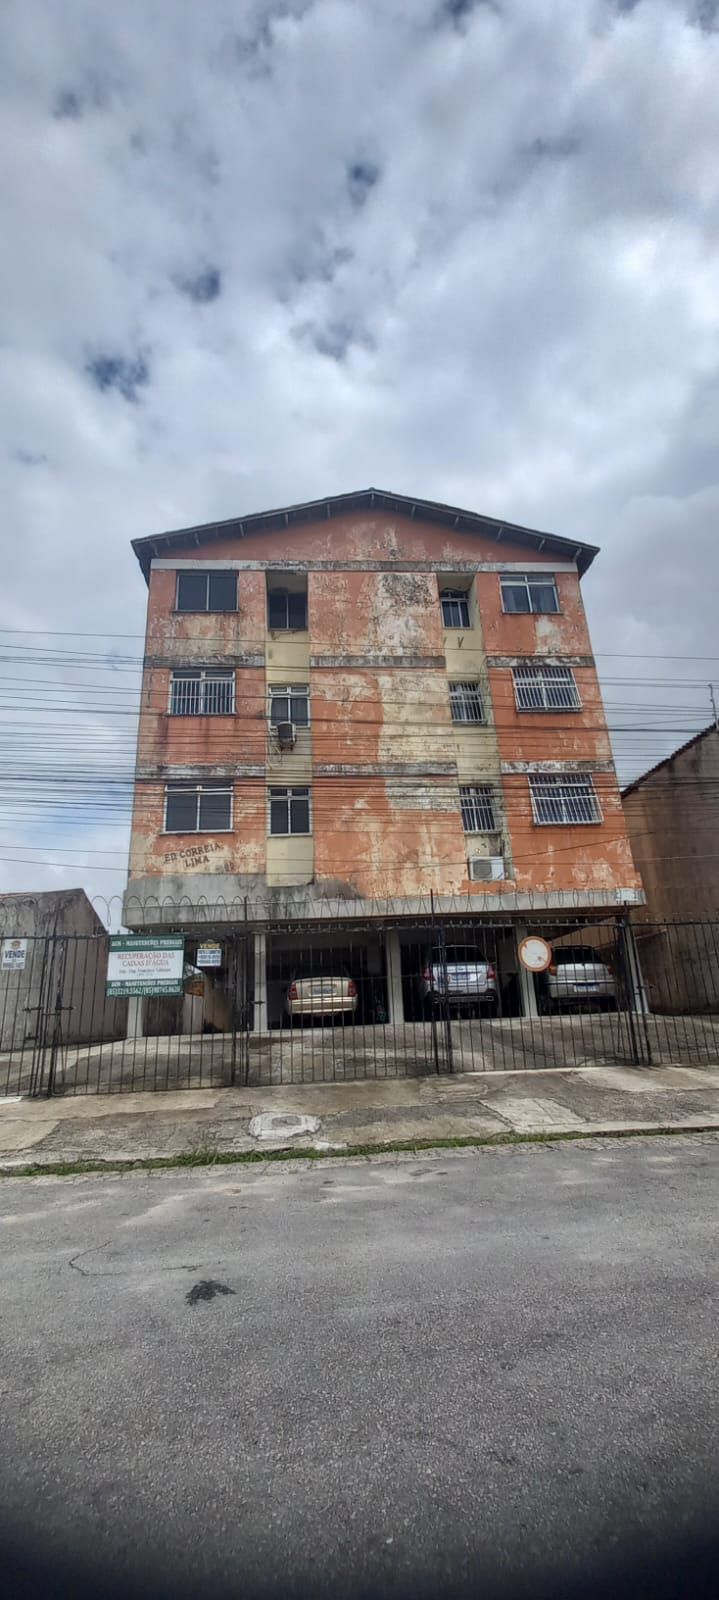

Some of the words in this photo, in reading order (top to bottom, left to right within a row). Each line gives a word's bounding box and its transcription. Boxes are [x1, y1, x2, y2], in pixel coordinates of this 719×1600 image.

[179, 842, 221, 858] CORREIA
[184, 855, 210, 868] LIMA
[4, 950, 25, 959] VENDE
[117, 951, 161, 961] RECUPERAÇÃO
[162, 951, 176, 960] DAS
[122, 959, 145, 968] CAIXAS
